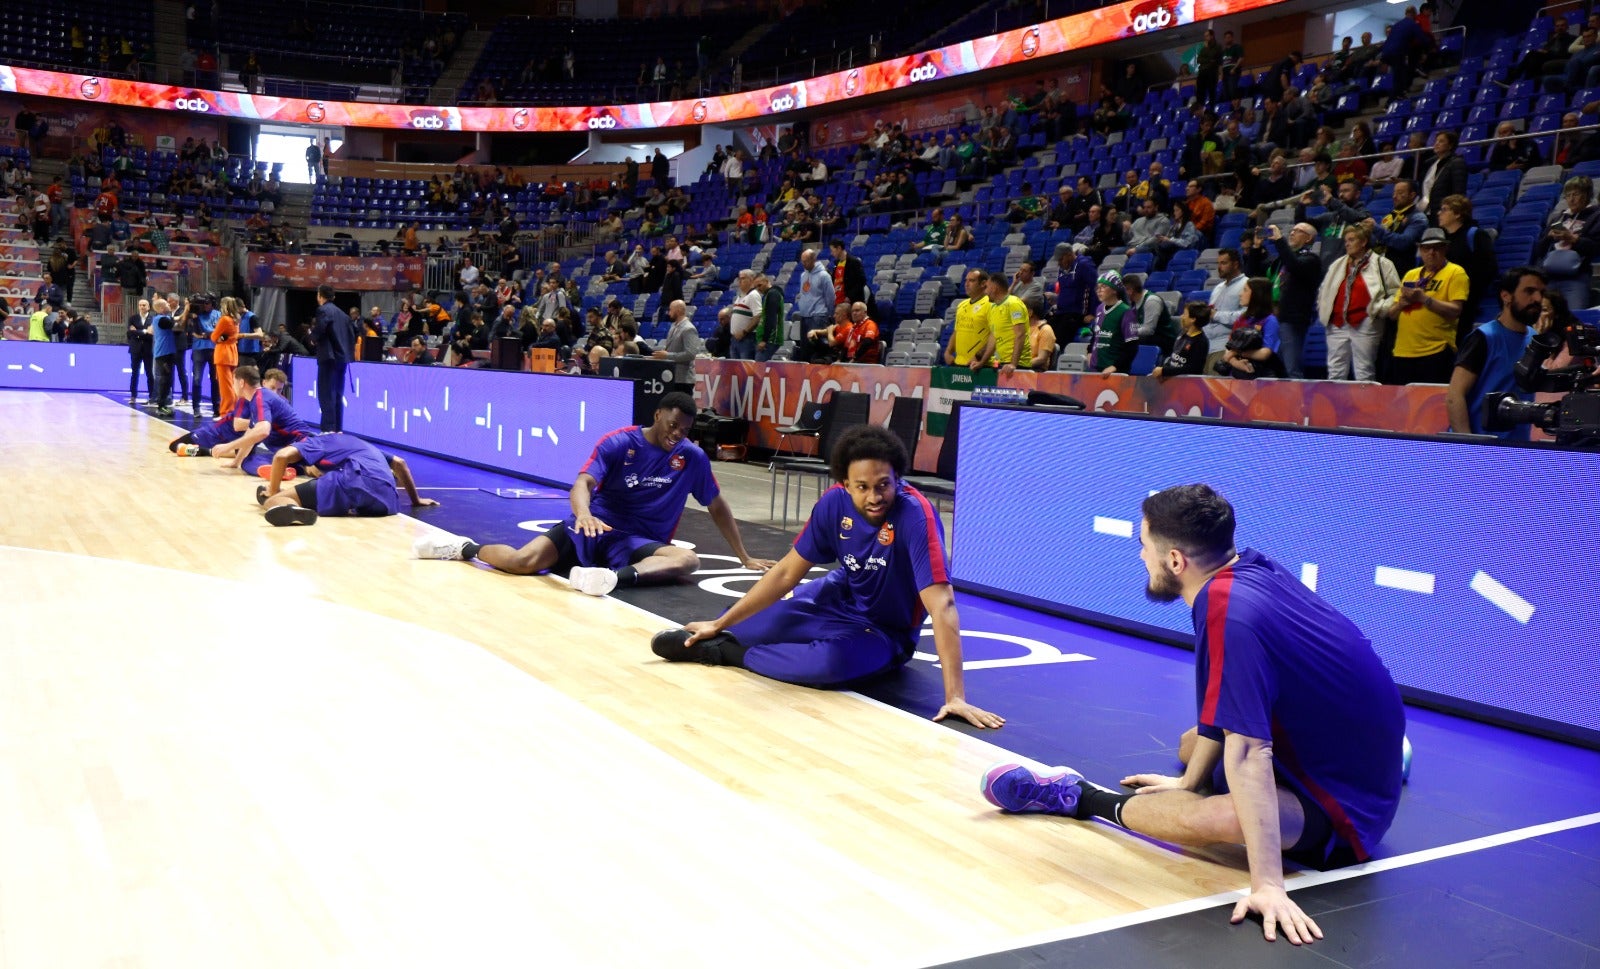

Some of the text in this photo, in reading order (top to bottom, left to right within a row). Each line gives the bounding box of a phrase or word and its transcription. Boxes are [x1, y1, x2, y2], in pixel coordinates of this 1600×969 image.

[1133, 6, 1171, 32] acb
[910, 61, 937, 82] acb
[175, 98, 209, 112] acb
[771, 94, 794, 112] acb
[413, 115, 444, 129] acb
[588, 114, 616, 129] acb
[917, 113, 955, 129] endesa
[334, 263, 365, 271] endesa
[951, 374, 972, 384] JIMENA
[730, 367, 861, 426] MÁLA
